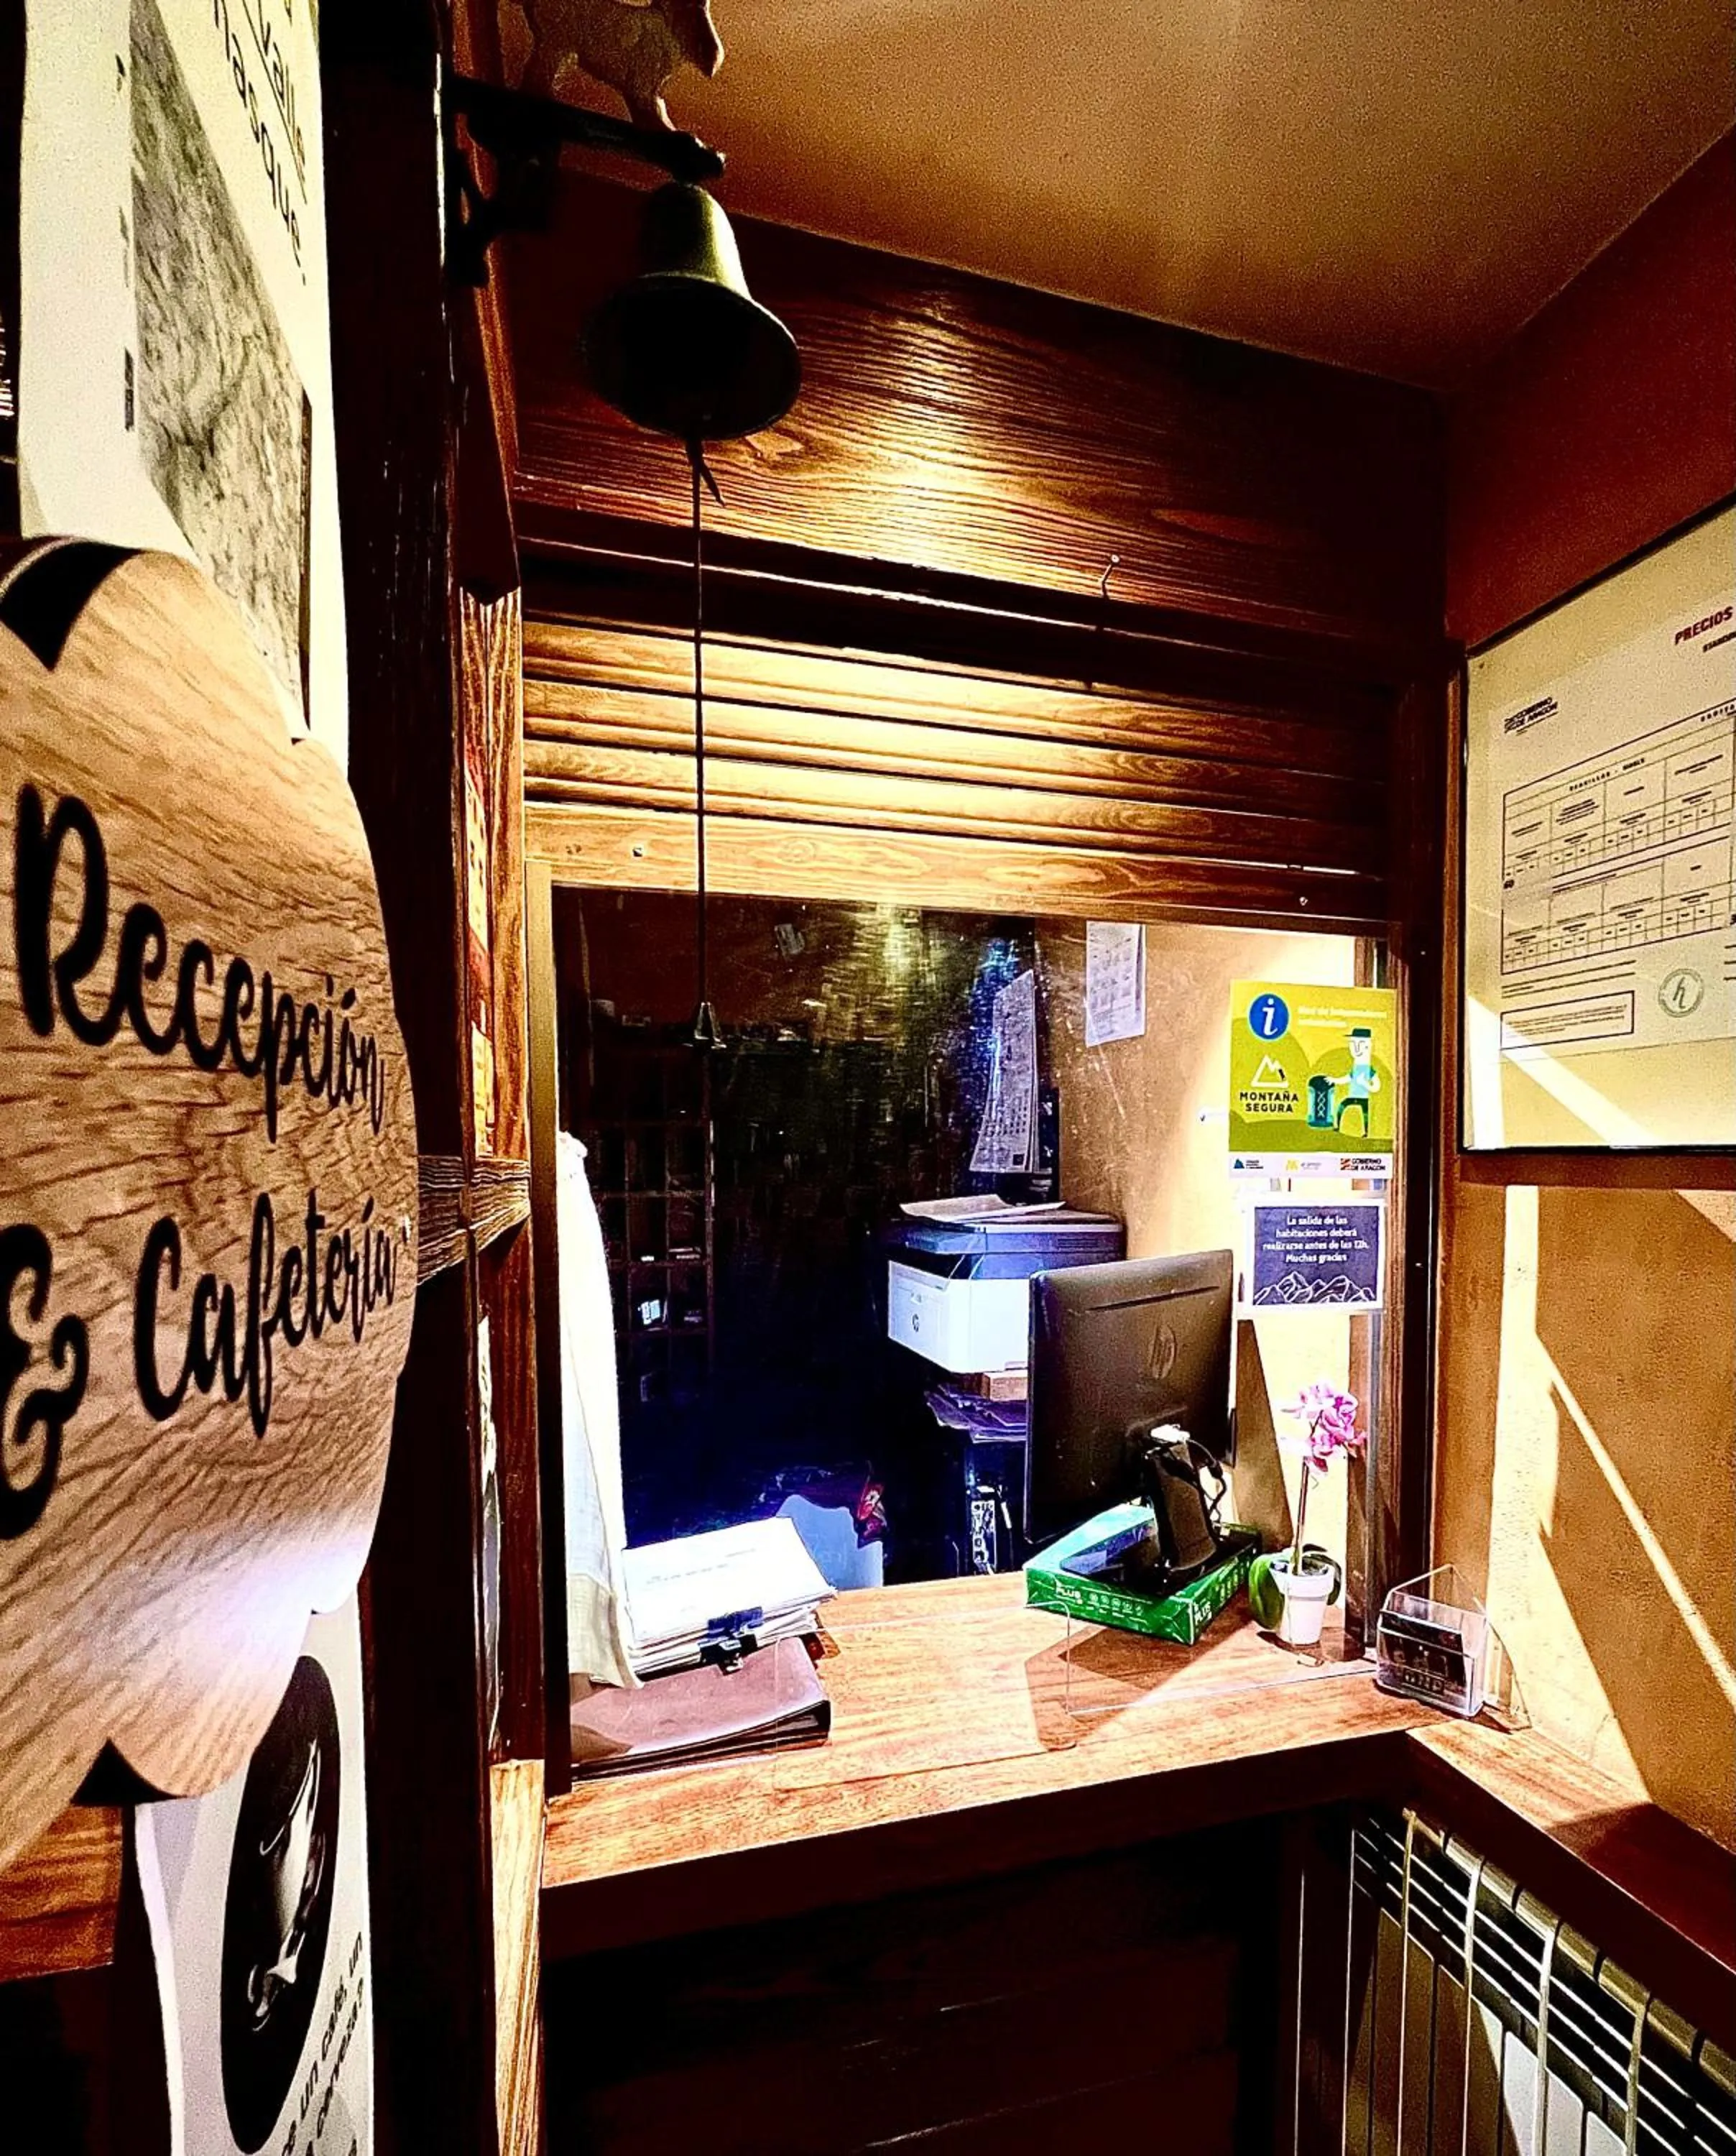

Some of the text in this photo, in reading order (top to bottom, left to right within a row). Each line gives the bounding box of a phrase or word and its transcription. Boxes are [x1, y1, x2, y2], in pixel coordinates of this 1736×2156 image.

[1674, 606, 1734, 645] PRECIOS
[14, 782, 384, 1144] Recepción
[1239, 1090, 1299, 1102] MONTAÑA
[1245, 1103, 1294, 1113] SEGURA
[1287, 1215, 1347, 1225] La salida de las
[1275, 1227, 1357, 1238] habitaciones deberá
[1262, 1241, 1303, 1250] realizarse
[1305, 1241, 1327, 1250] antes
[1329, 1240, 1339, 1249] de
[1341, 1240, 1352, 1249] las
[1285, 1253, 1348, 1264] Muchas gracias
[0, 1187, 398, 1540] & Cafetería
[300, 2060, 318, 2121] un
[321, 1974, 347, 2061] café,
[349, 1930, 363, 1978] un
